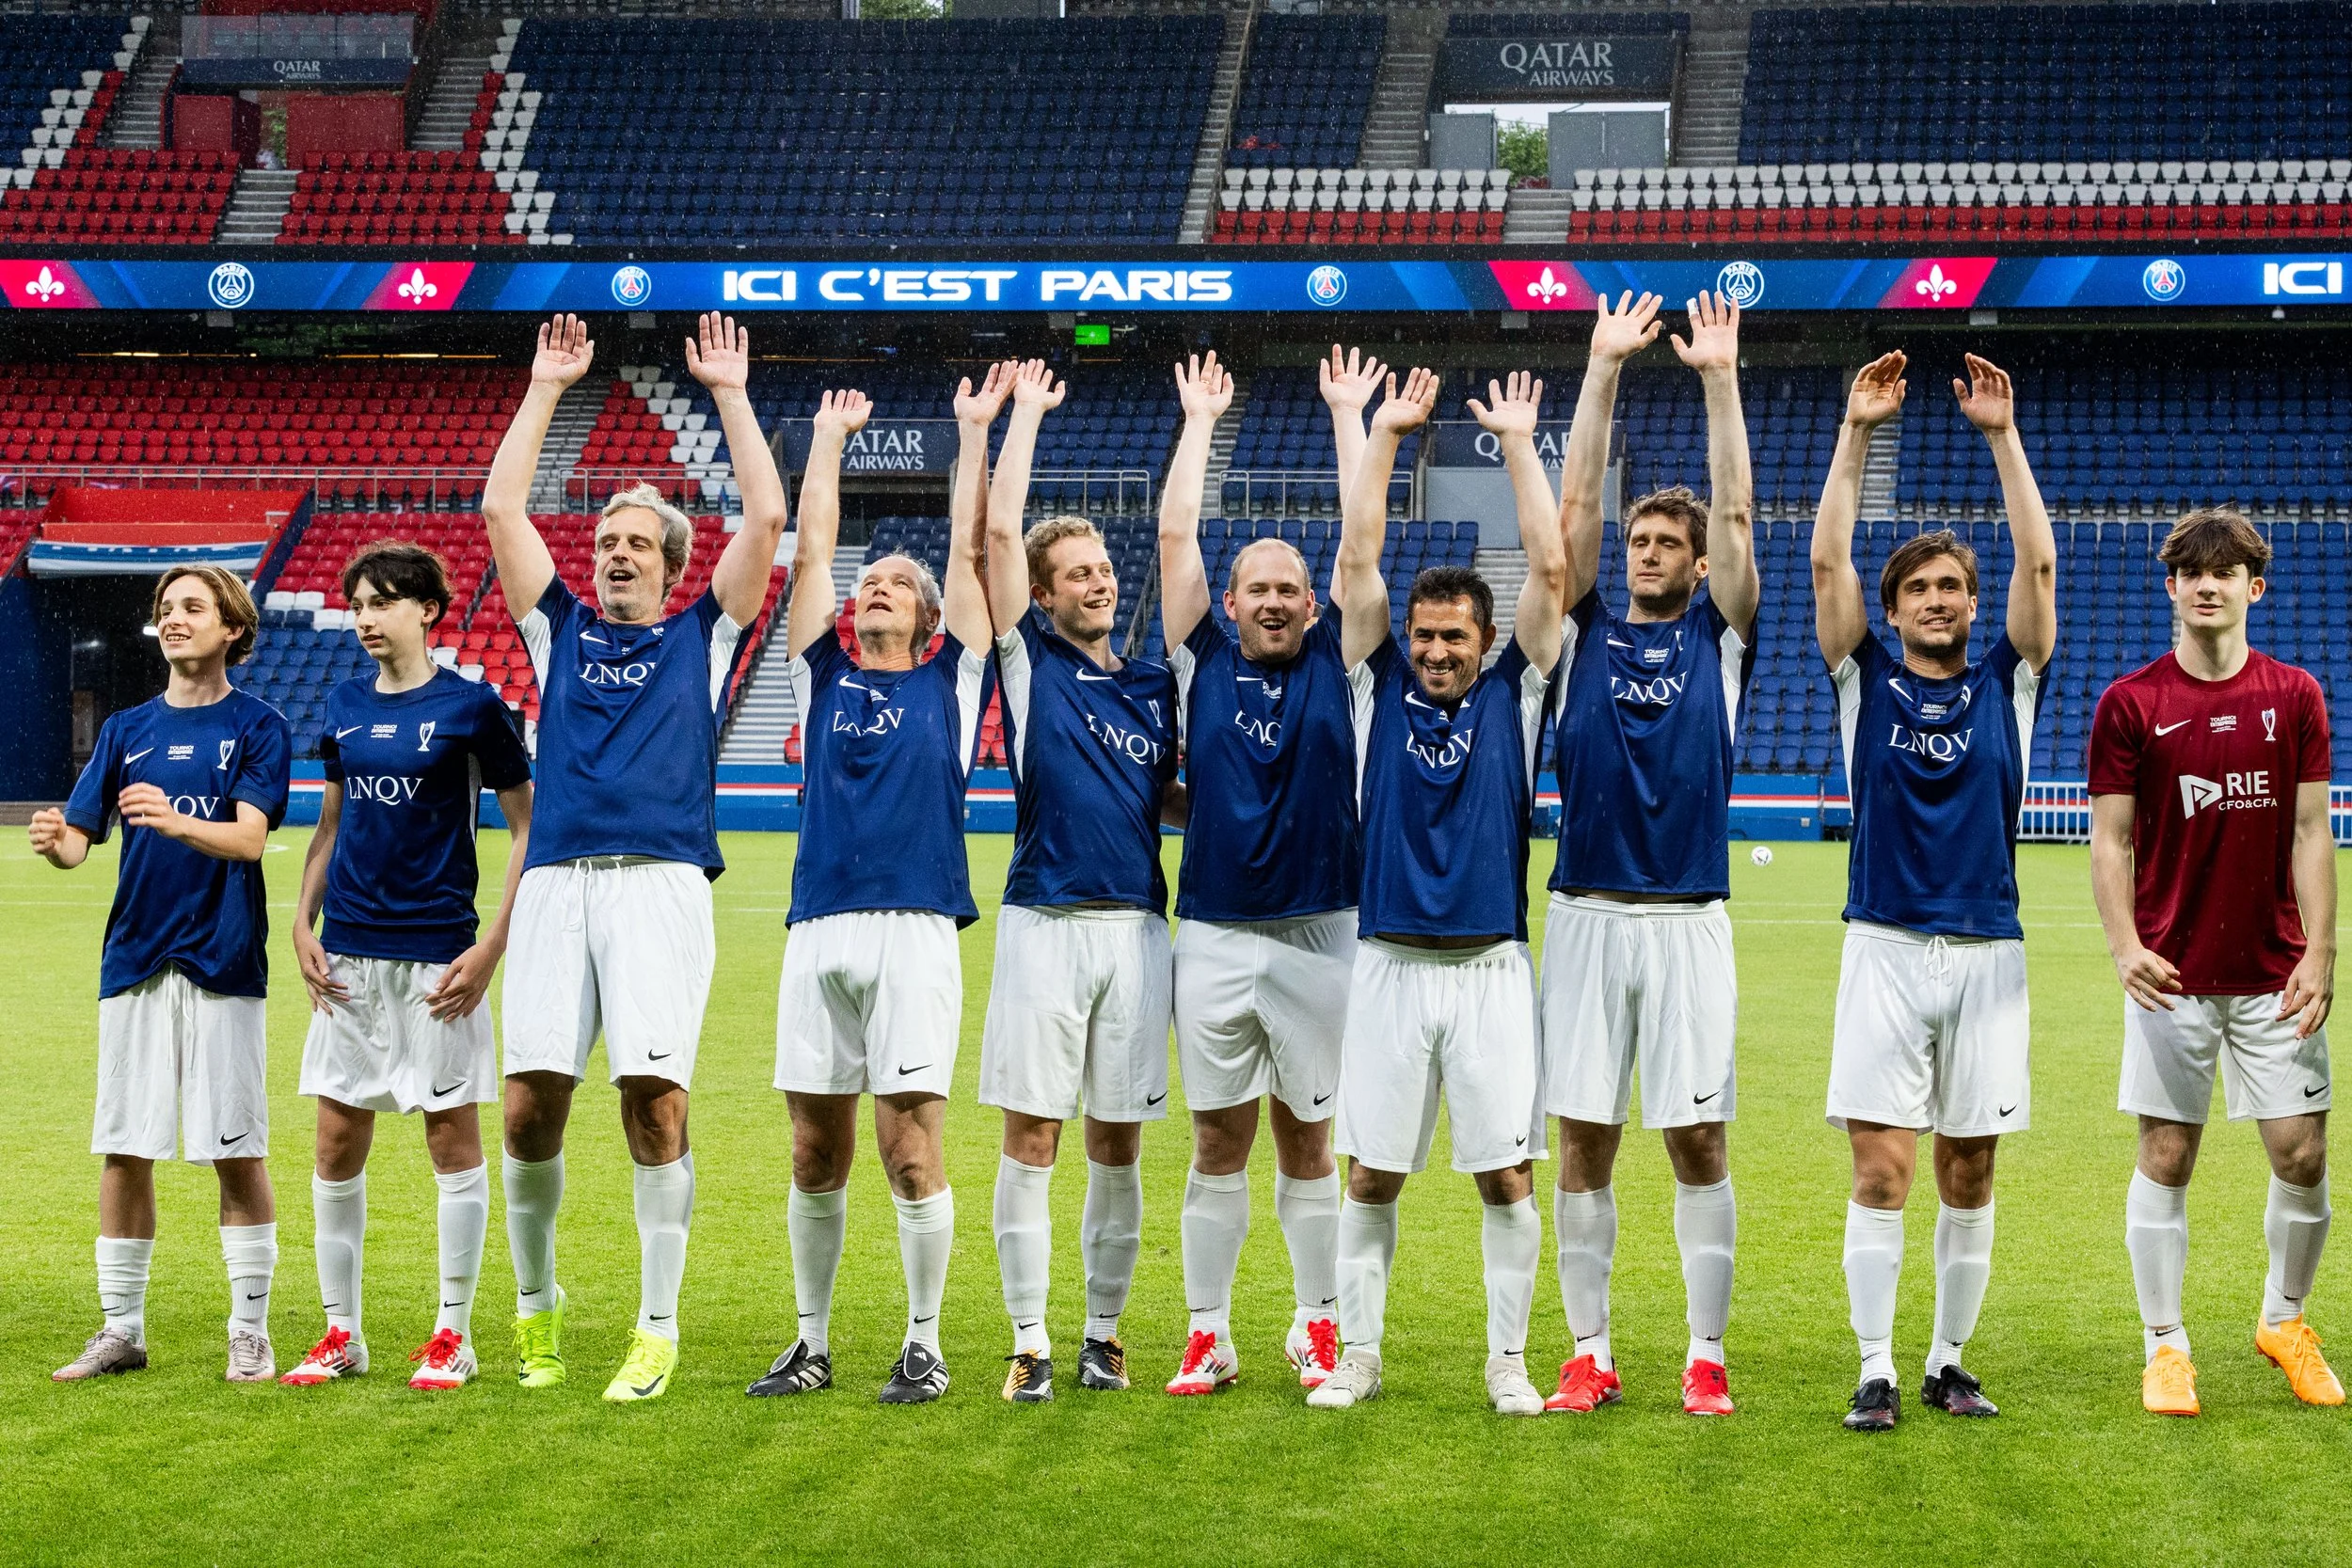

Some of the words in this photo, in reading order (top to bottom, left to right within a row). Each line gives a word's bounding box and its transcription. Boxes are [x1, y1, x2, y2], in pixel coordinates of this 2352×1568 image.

[273, 60, 321, 74] QATAR
[1500, 40, 1613, 75] QATAR
[285, 72, 322, 81] AIRWAYS
[1528, 70, 1615, 87] AIRWAYS
[723, 270, 797, 301] ICI
[818, 267, 1018, 301] C'EST
[1041, 270, 1233, 302] PARIS
[2264, 261, 2343, 294] ICI
[842, 429, 924, 458] ATAR
[847, 454, 925, 470] AIRWAYS
[1610, 671, 1688, 706] LNQV
[1887, 722, 1974, 762] LNQV
[346, 776, 424, 806] LNQV
[2225, 770, 2270, 797] RIE
[2217, 798, 2278, 811] CFO&CFA
